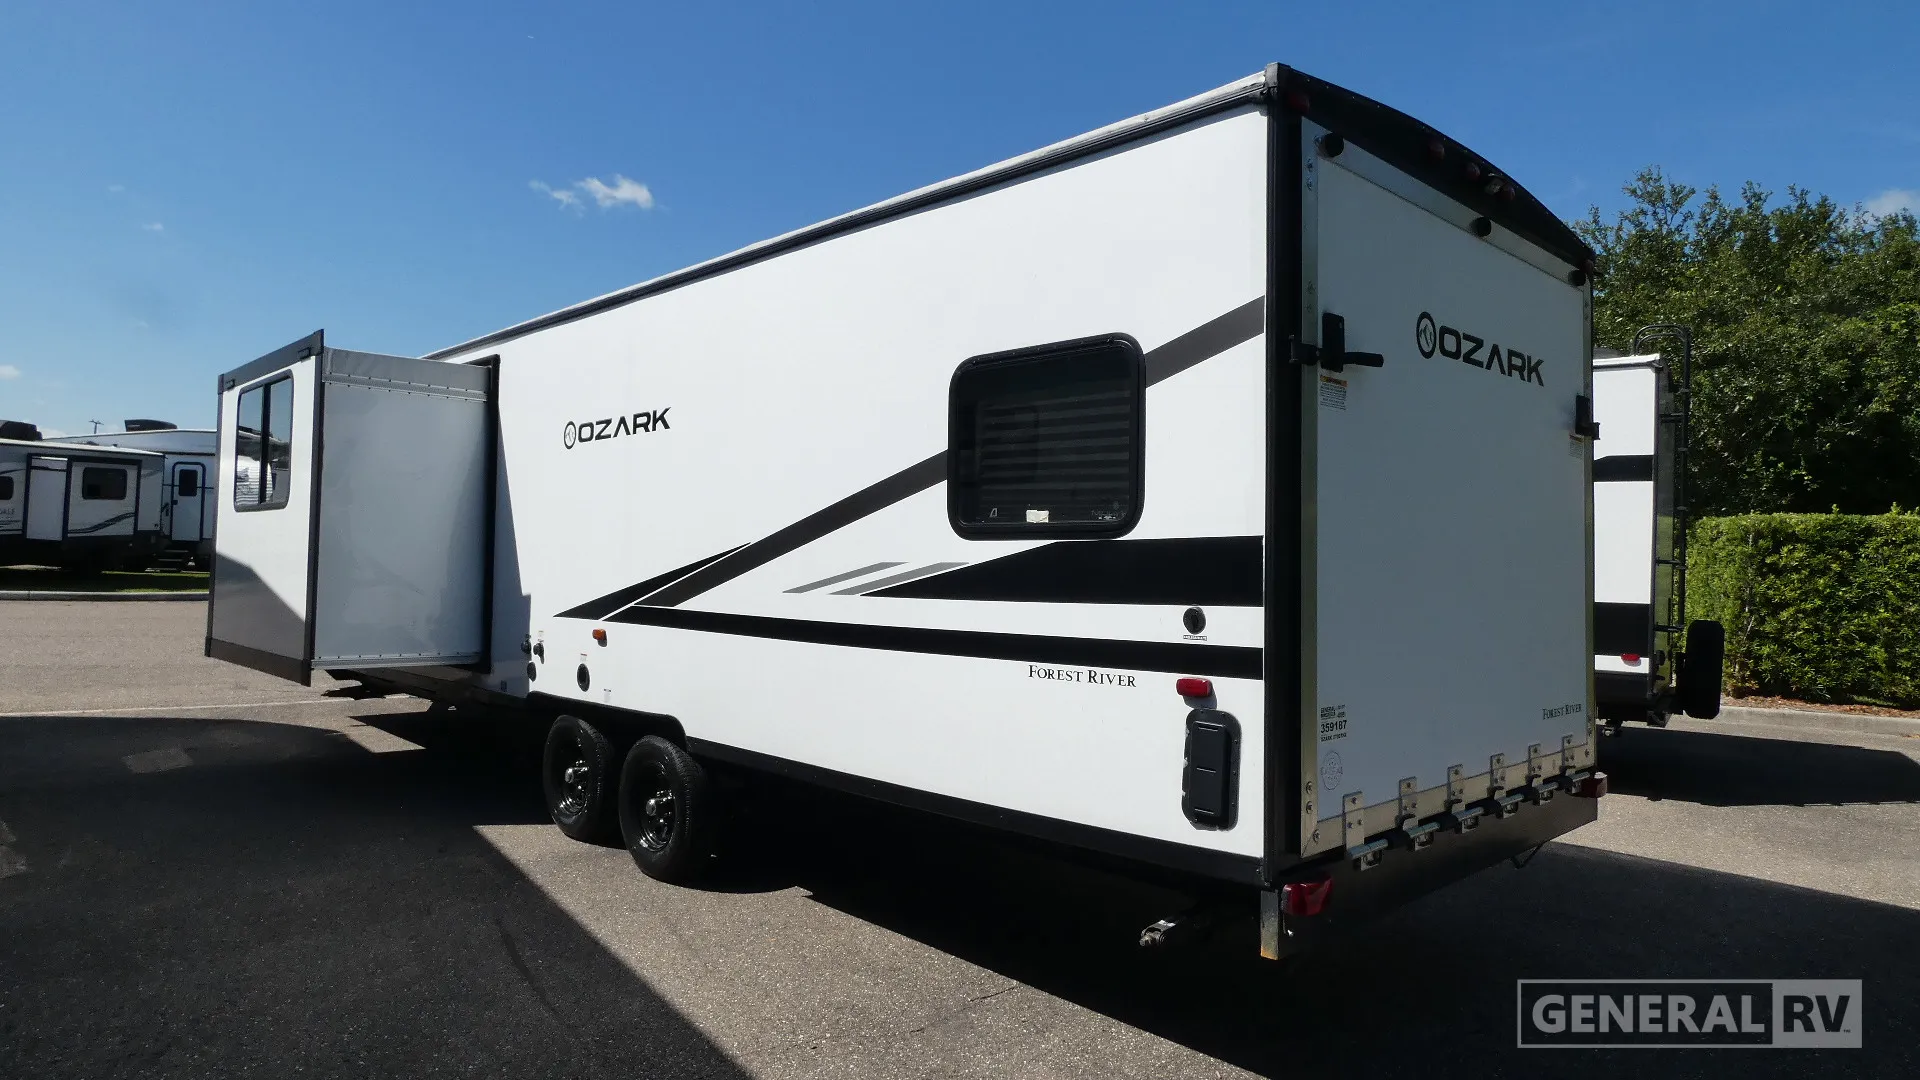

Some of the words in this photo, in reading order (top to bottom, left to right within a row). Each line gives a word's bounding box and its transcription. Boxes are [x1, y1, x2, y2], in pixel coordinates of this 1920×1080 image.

[1438, 325, 1545, 387] OZARK
[577, 406, 672, 443] OZARK
[1028, 664, 1083, 683] FOREST
[1087, 669, 1137, 688] RIVER
[1321, 720, 1347, 733] 359187
